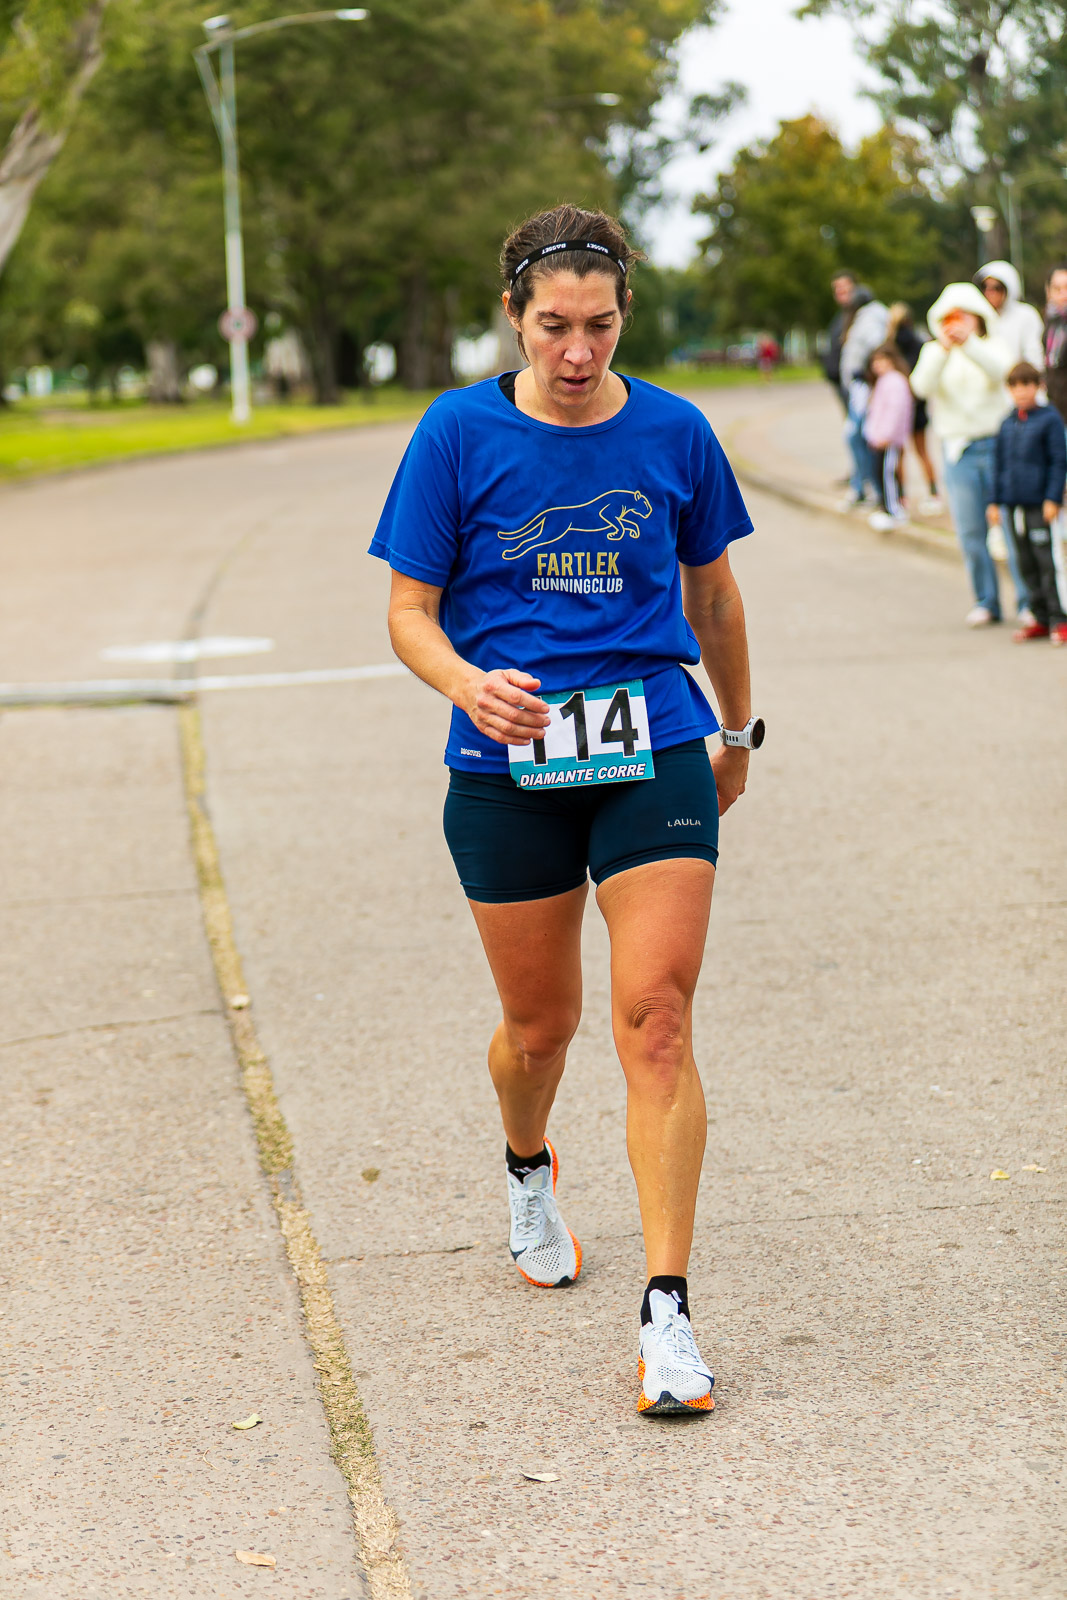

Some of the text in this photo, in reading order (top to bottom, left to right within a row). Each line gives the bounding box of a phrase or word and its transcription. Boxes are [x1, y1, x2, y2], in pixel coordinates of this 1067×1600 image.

[541, 243, 567, 255] BASSET
[537, 552, 620, 576] FARTLEK
[531, 577, 624, 594] RUNNINGCLUB
[519, 763, 647, 787] DIAMANTE CORRE
